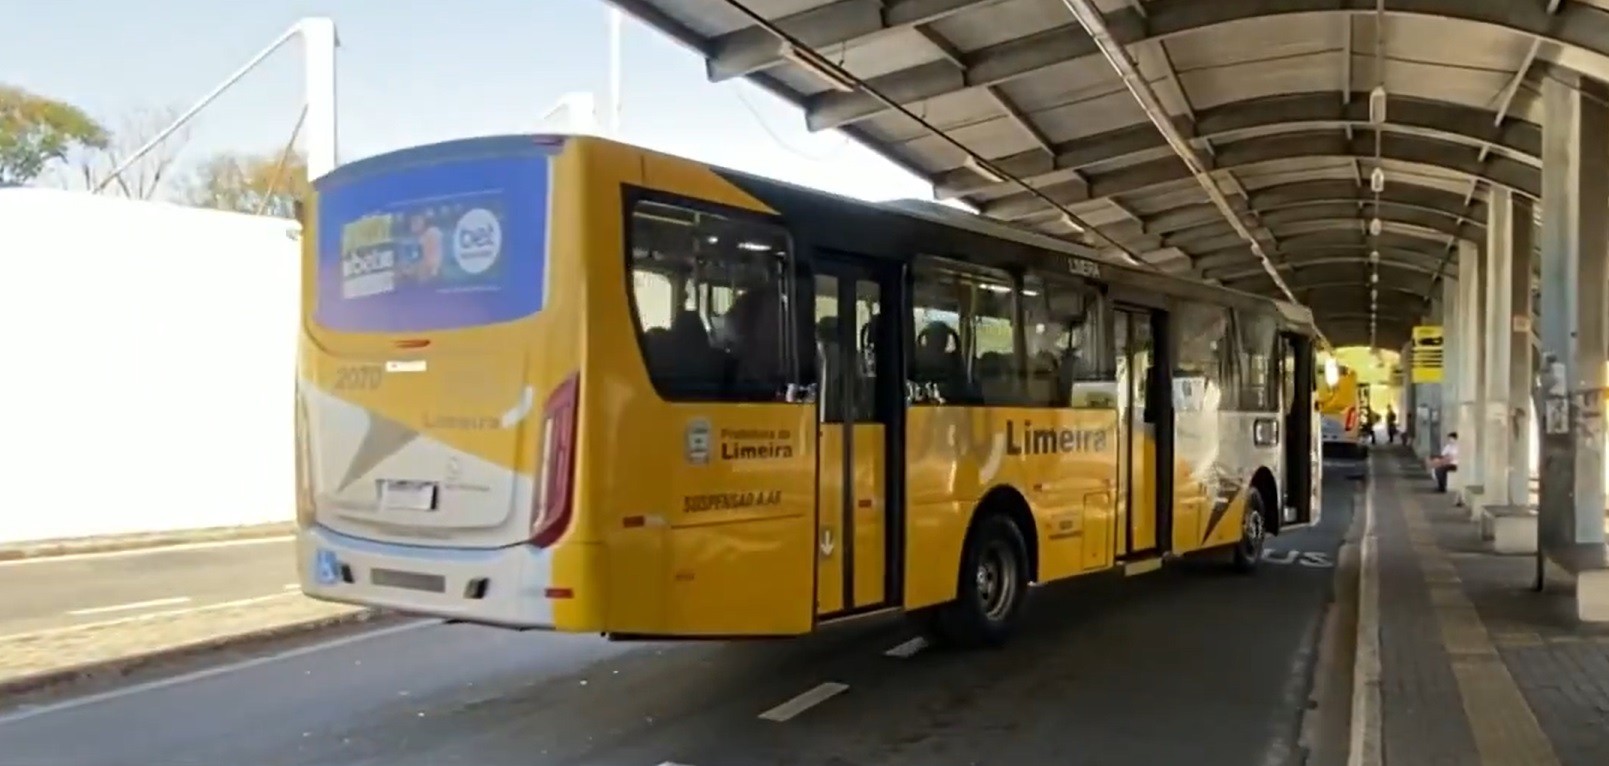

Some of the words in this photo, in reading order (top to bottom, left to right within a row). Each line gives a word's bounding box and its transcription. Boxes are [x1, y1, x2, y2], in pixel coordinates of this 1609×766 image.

[335, 365, 383, 390] 2070
[1006, 419, 1108, 455] Limeira
[721, 442, 793, 460] Limeira
